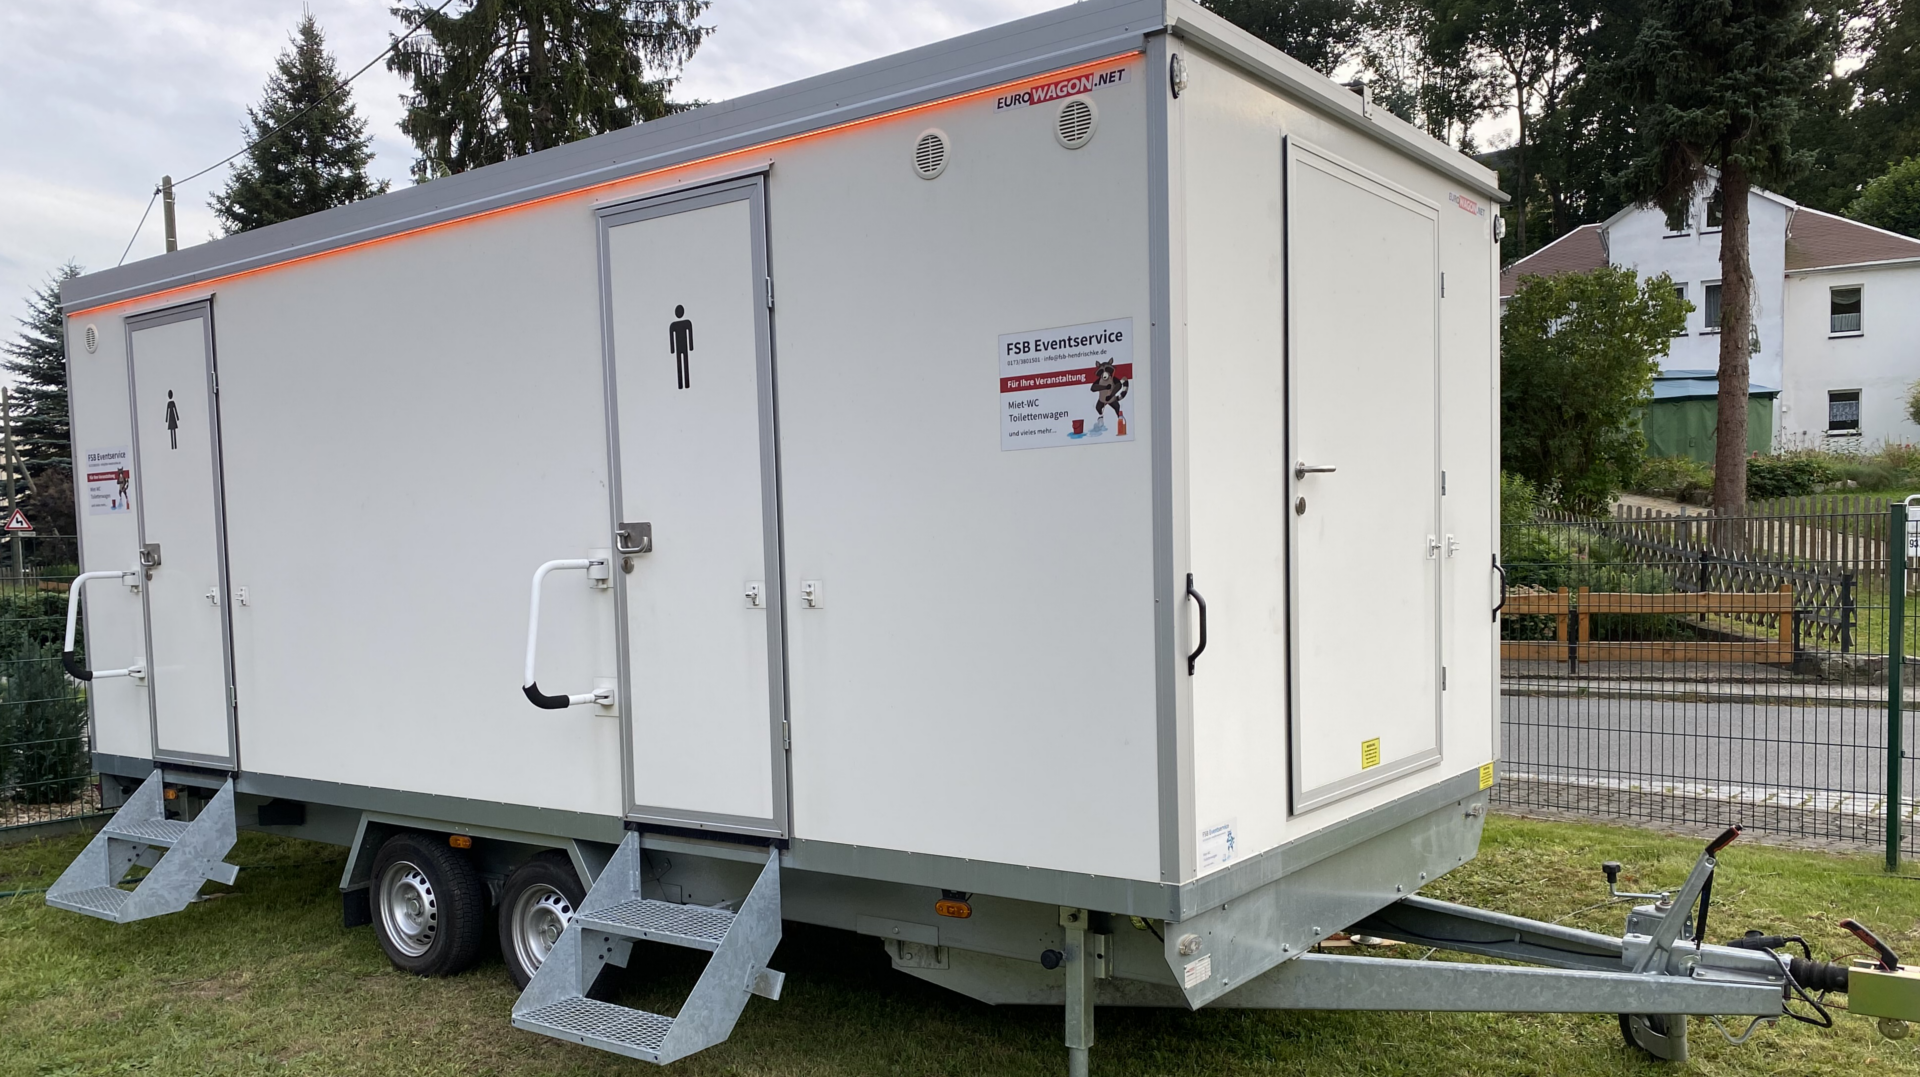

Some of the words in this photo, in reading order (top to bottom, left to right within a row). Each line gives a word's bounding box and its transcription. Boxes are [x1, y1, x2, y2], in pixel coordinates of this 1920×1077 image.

[996, 68, 1125, 110] EUROWAGON.NET
[1006, 340, 1030, 356] FSB
[1034, 329, 1123, 352] Eventservice
[1044, 348, 1107, 362] info@fsb-hendrischke.de
[1008, 380, 1019, 388] Für
[1020, 378, 1034, 387] Ihre
[1035, 373, 1086, 386] Veranstaltung
[1008, 398, 1039, 410] Miet-WC
[1009, 410, 1069, 422] Toilettenwagen
[1020, 428, 1036, 436] vieles
[88, 453, 96, 462] FSB
[97, 450, 126, 461] Eventservice
